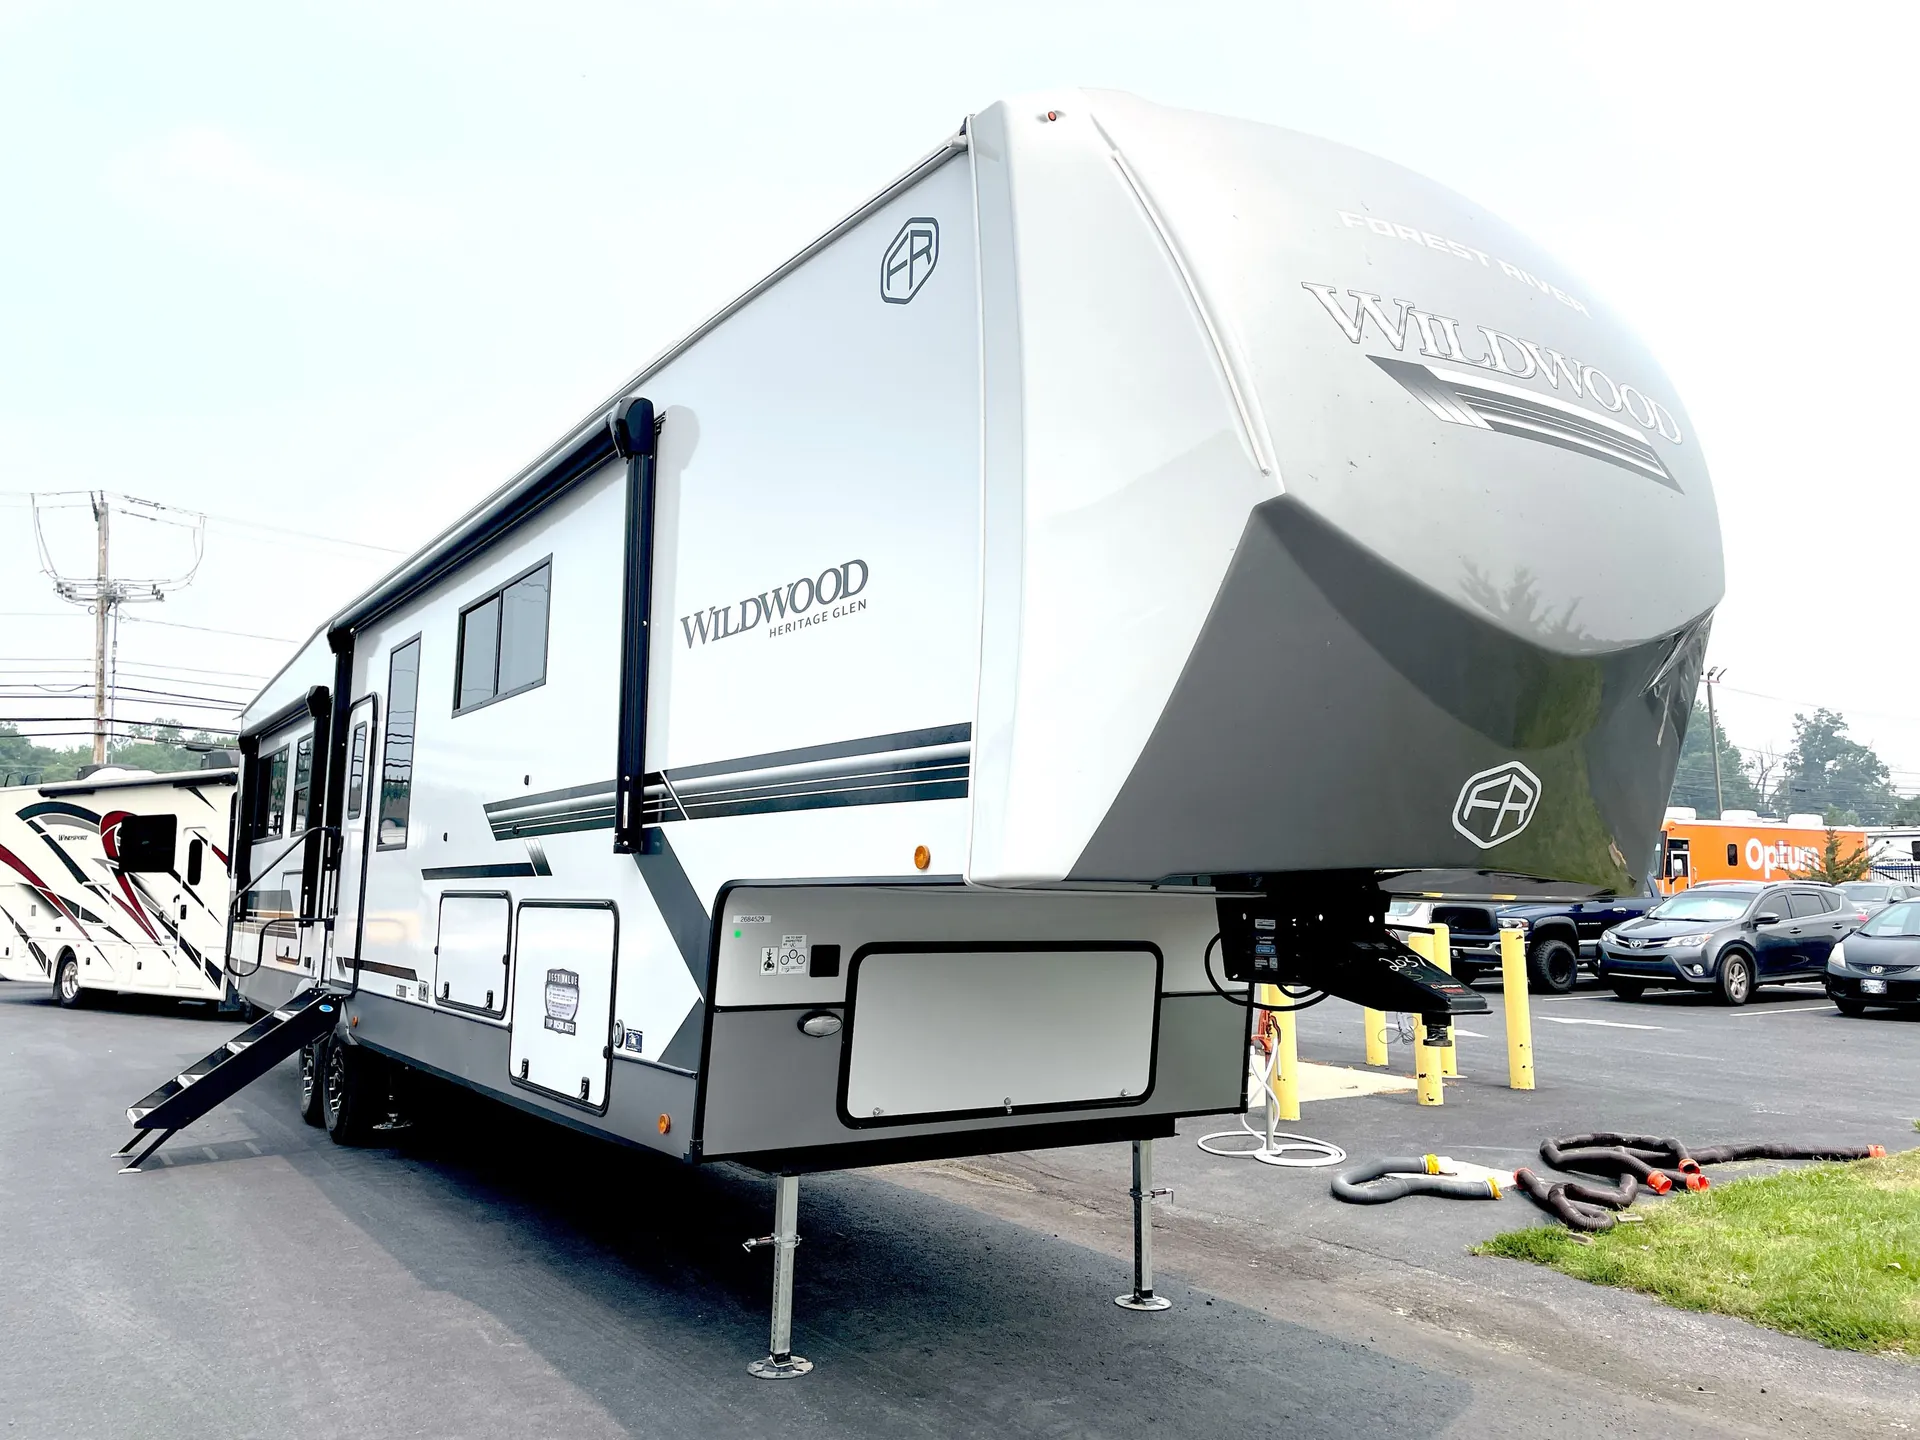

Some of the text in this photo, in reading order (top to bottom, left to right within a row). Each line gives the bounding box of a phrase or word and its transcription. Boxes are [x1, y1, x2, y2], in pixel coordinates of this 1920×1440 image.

[1335, 209, 1593, 320] FOREST RIVER
[1300, 281, 1683, 446] WILDWOOD
[680, 558, 869, 650] WILDWOOD
[769, 598, 868, 639] HERITAGE GLEN
[1745, 838, 1821, 879] Optum
[1378, 954, 1427, 972] 2037
